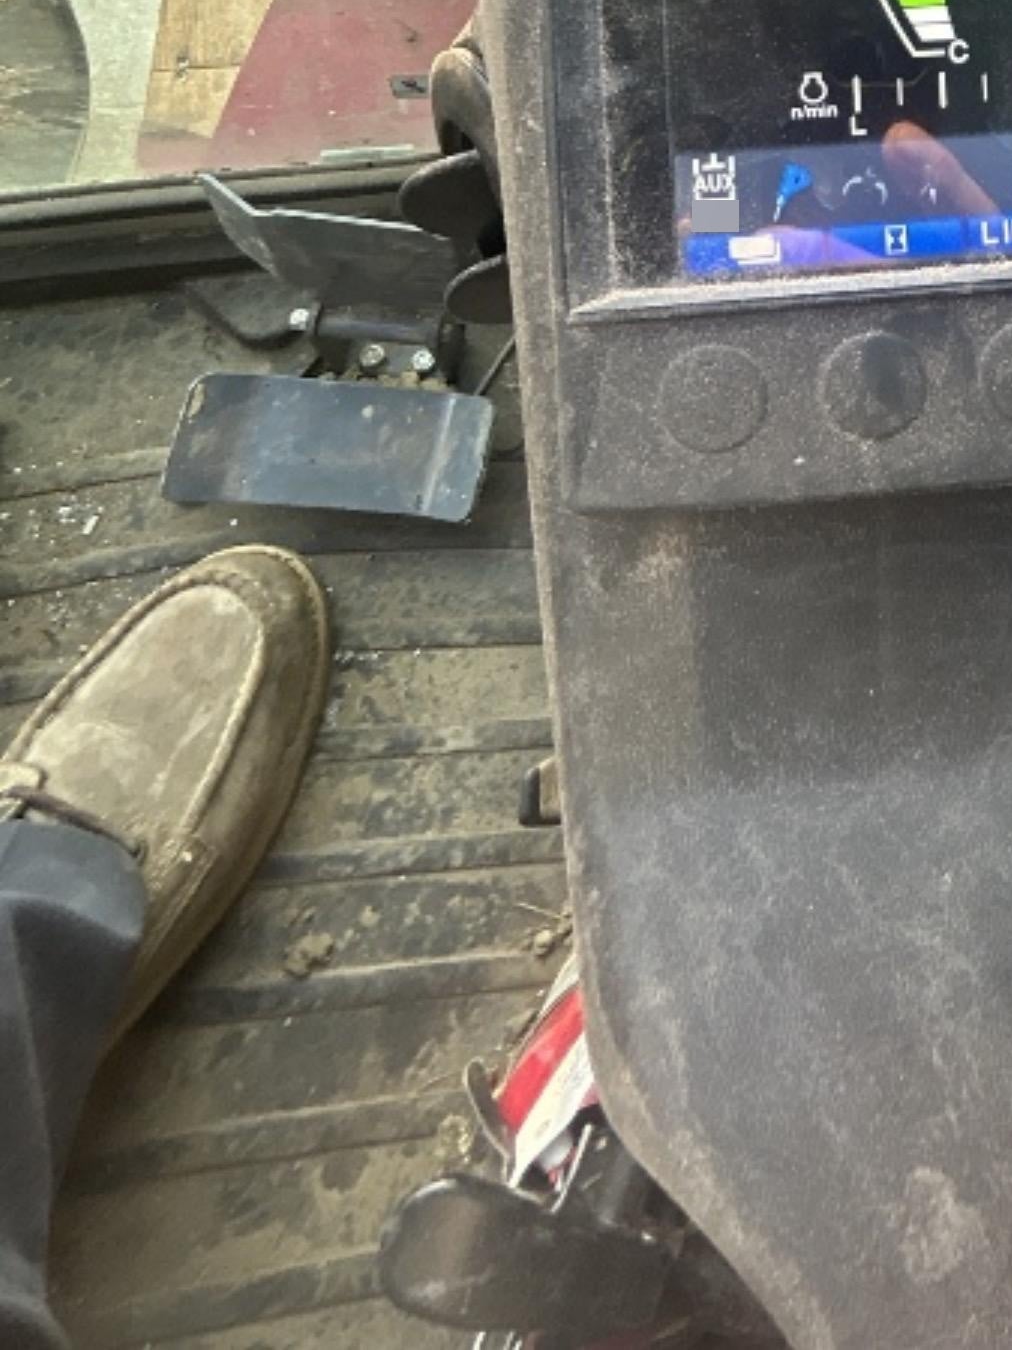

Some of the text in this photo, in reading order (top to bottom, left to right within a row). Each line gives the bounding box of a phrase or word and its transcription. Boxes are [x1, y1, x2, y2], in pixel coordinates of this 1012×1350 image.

[948, 38, 970, 64] C
[790, 104, 838, 120] n/min
[850, 116, 867, 136] L
[693, 173, 736, 193] AUX
[980, 220, 999, 245] L
